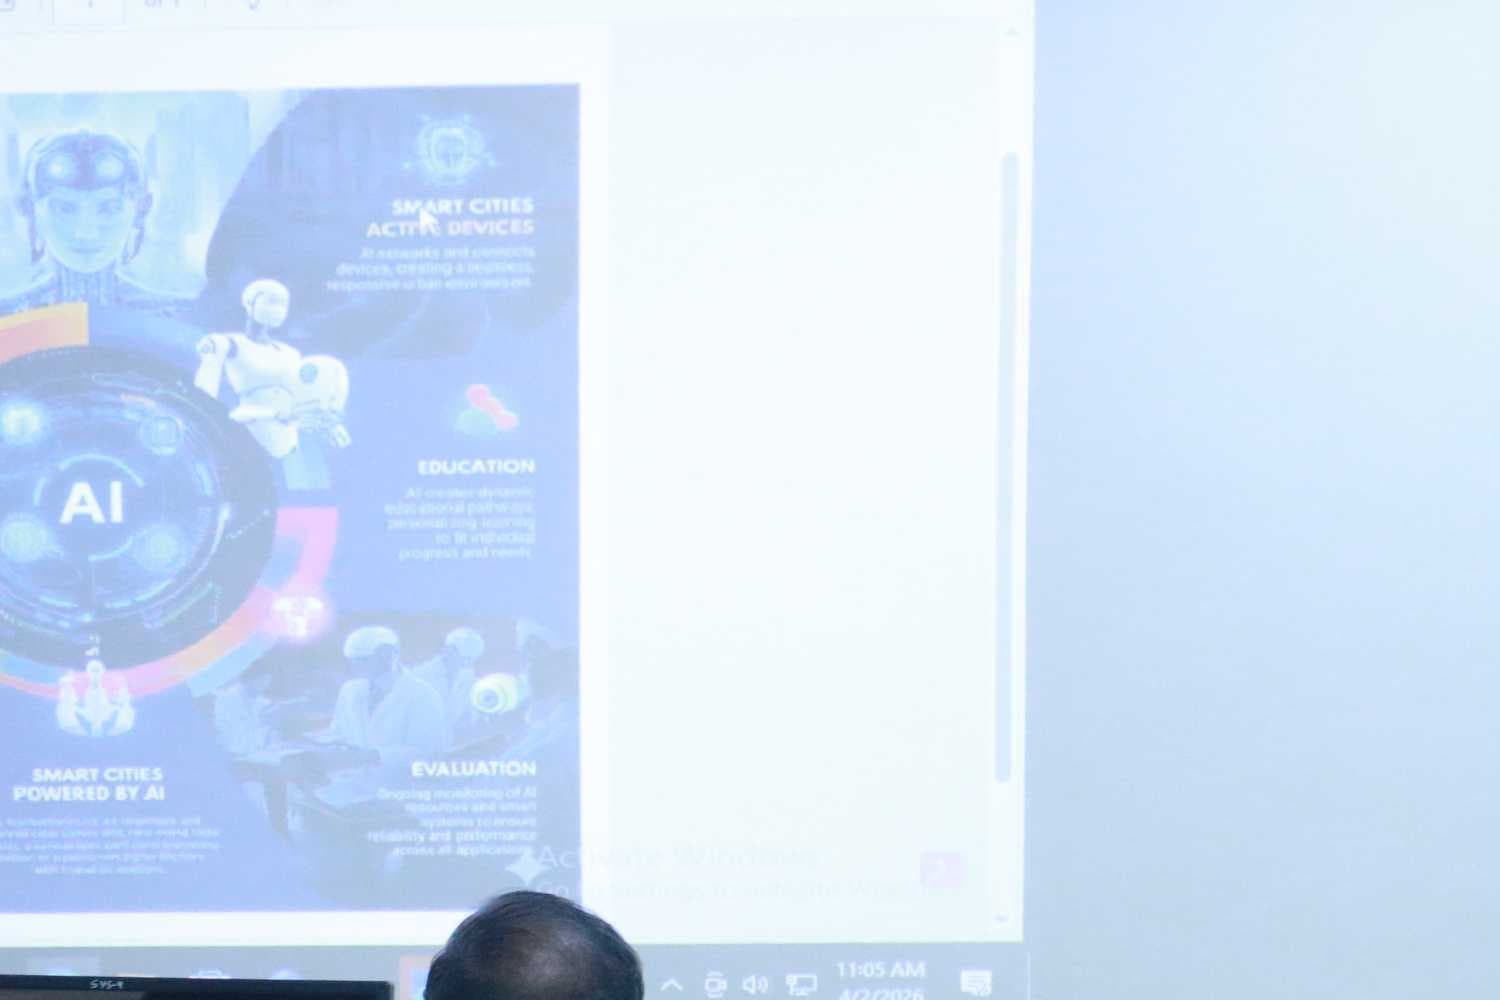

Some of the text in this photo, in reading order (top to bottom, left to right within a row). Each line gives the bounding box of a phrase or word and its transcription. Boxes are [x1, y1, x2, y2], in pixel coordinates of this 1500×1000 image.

[392, 196, 535, 216] SMART CITIES
[366, 219, 535, 238] ACTIE DEVICES
[417, 458, 536, 476] EDUCATION
[59, 479, 124, 525] AI
[32, 767, 164, 782] SMART CITIES
[411, 760, 537, 777] EVALUATION
[12, 785, 166, 801] POWERED BY AI
[836, 960, 927, 978] 11:05 AM
